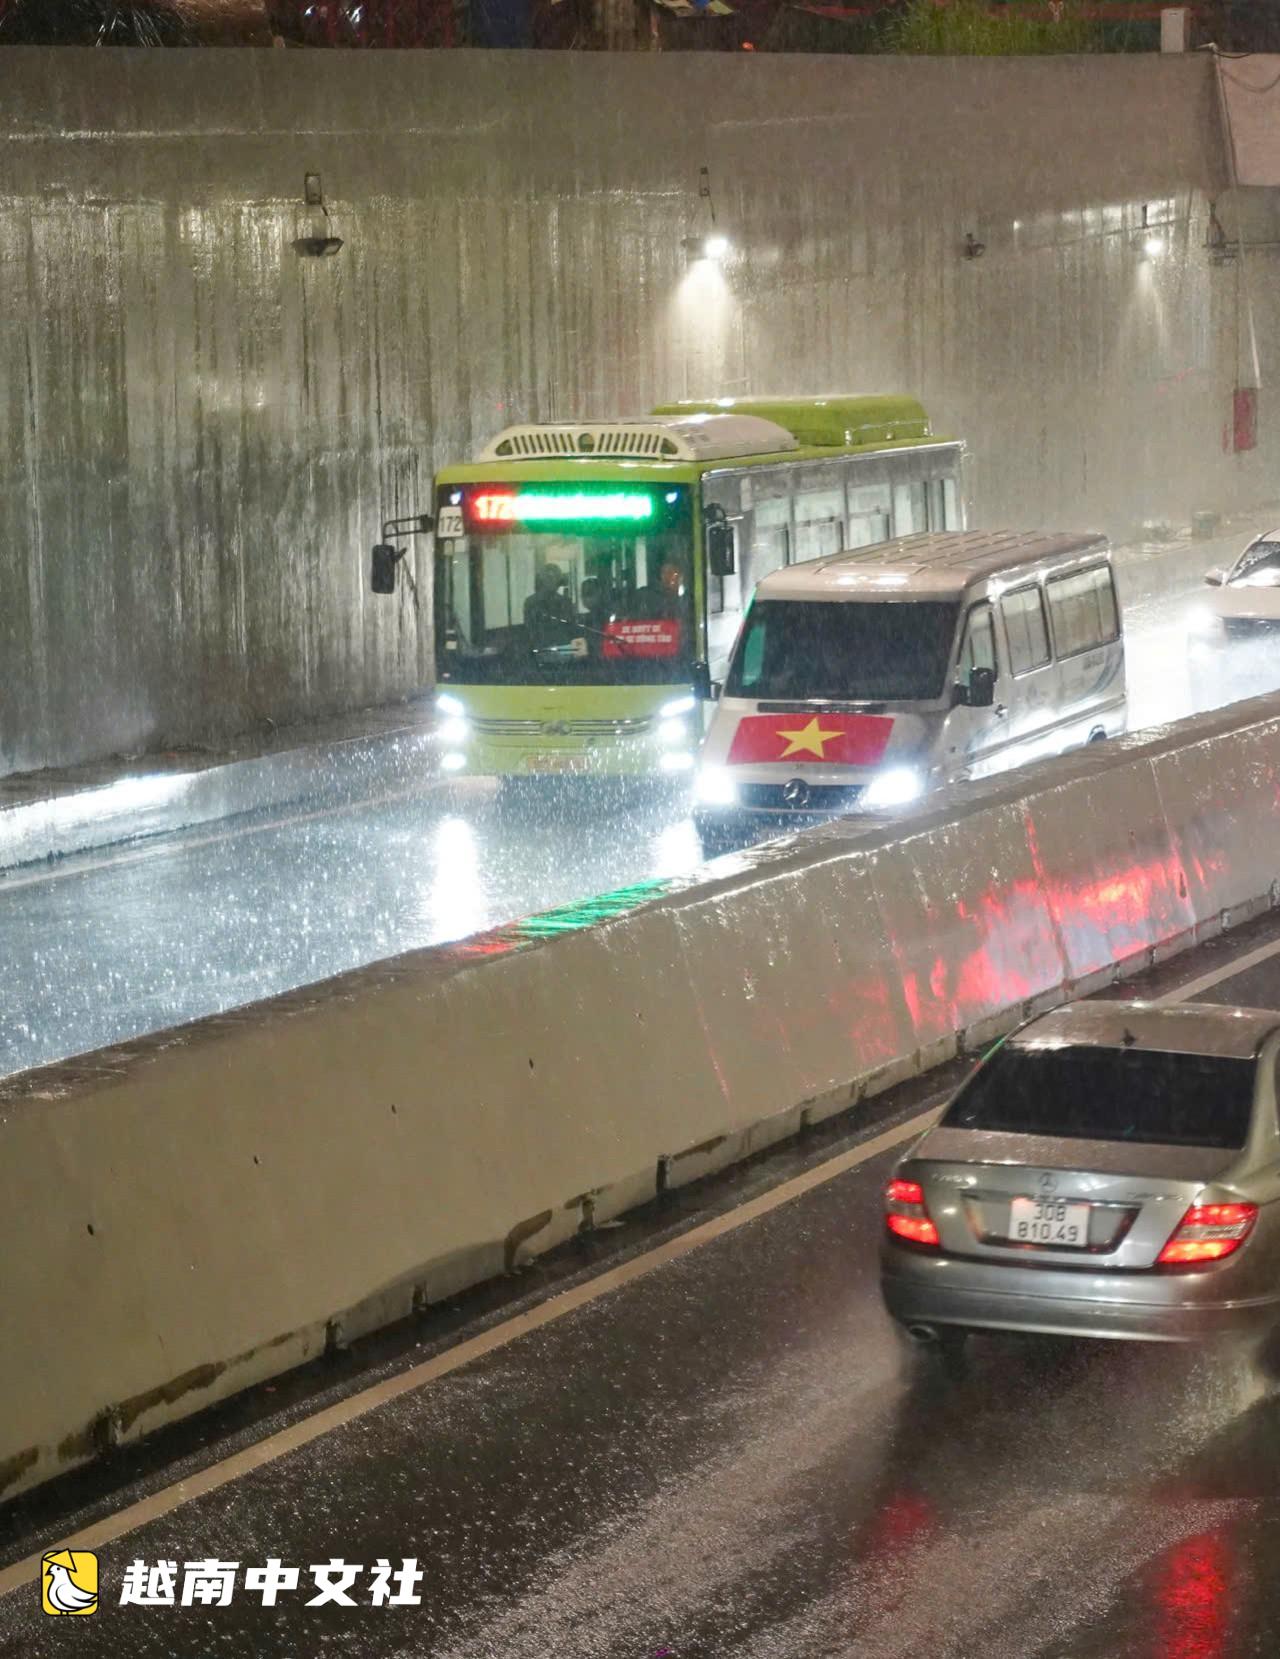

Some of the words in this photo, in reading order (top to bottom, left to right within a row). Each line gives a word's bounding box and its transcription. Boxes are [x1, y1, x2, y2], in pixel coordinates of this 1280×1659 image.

[439, 516, 463, 533] 172
[1034, 1203, 1066, 1222] 30B
[1018, 1221, 1078, 1242] 810.49
